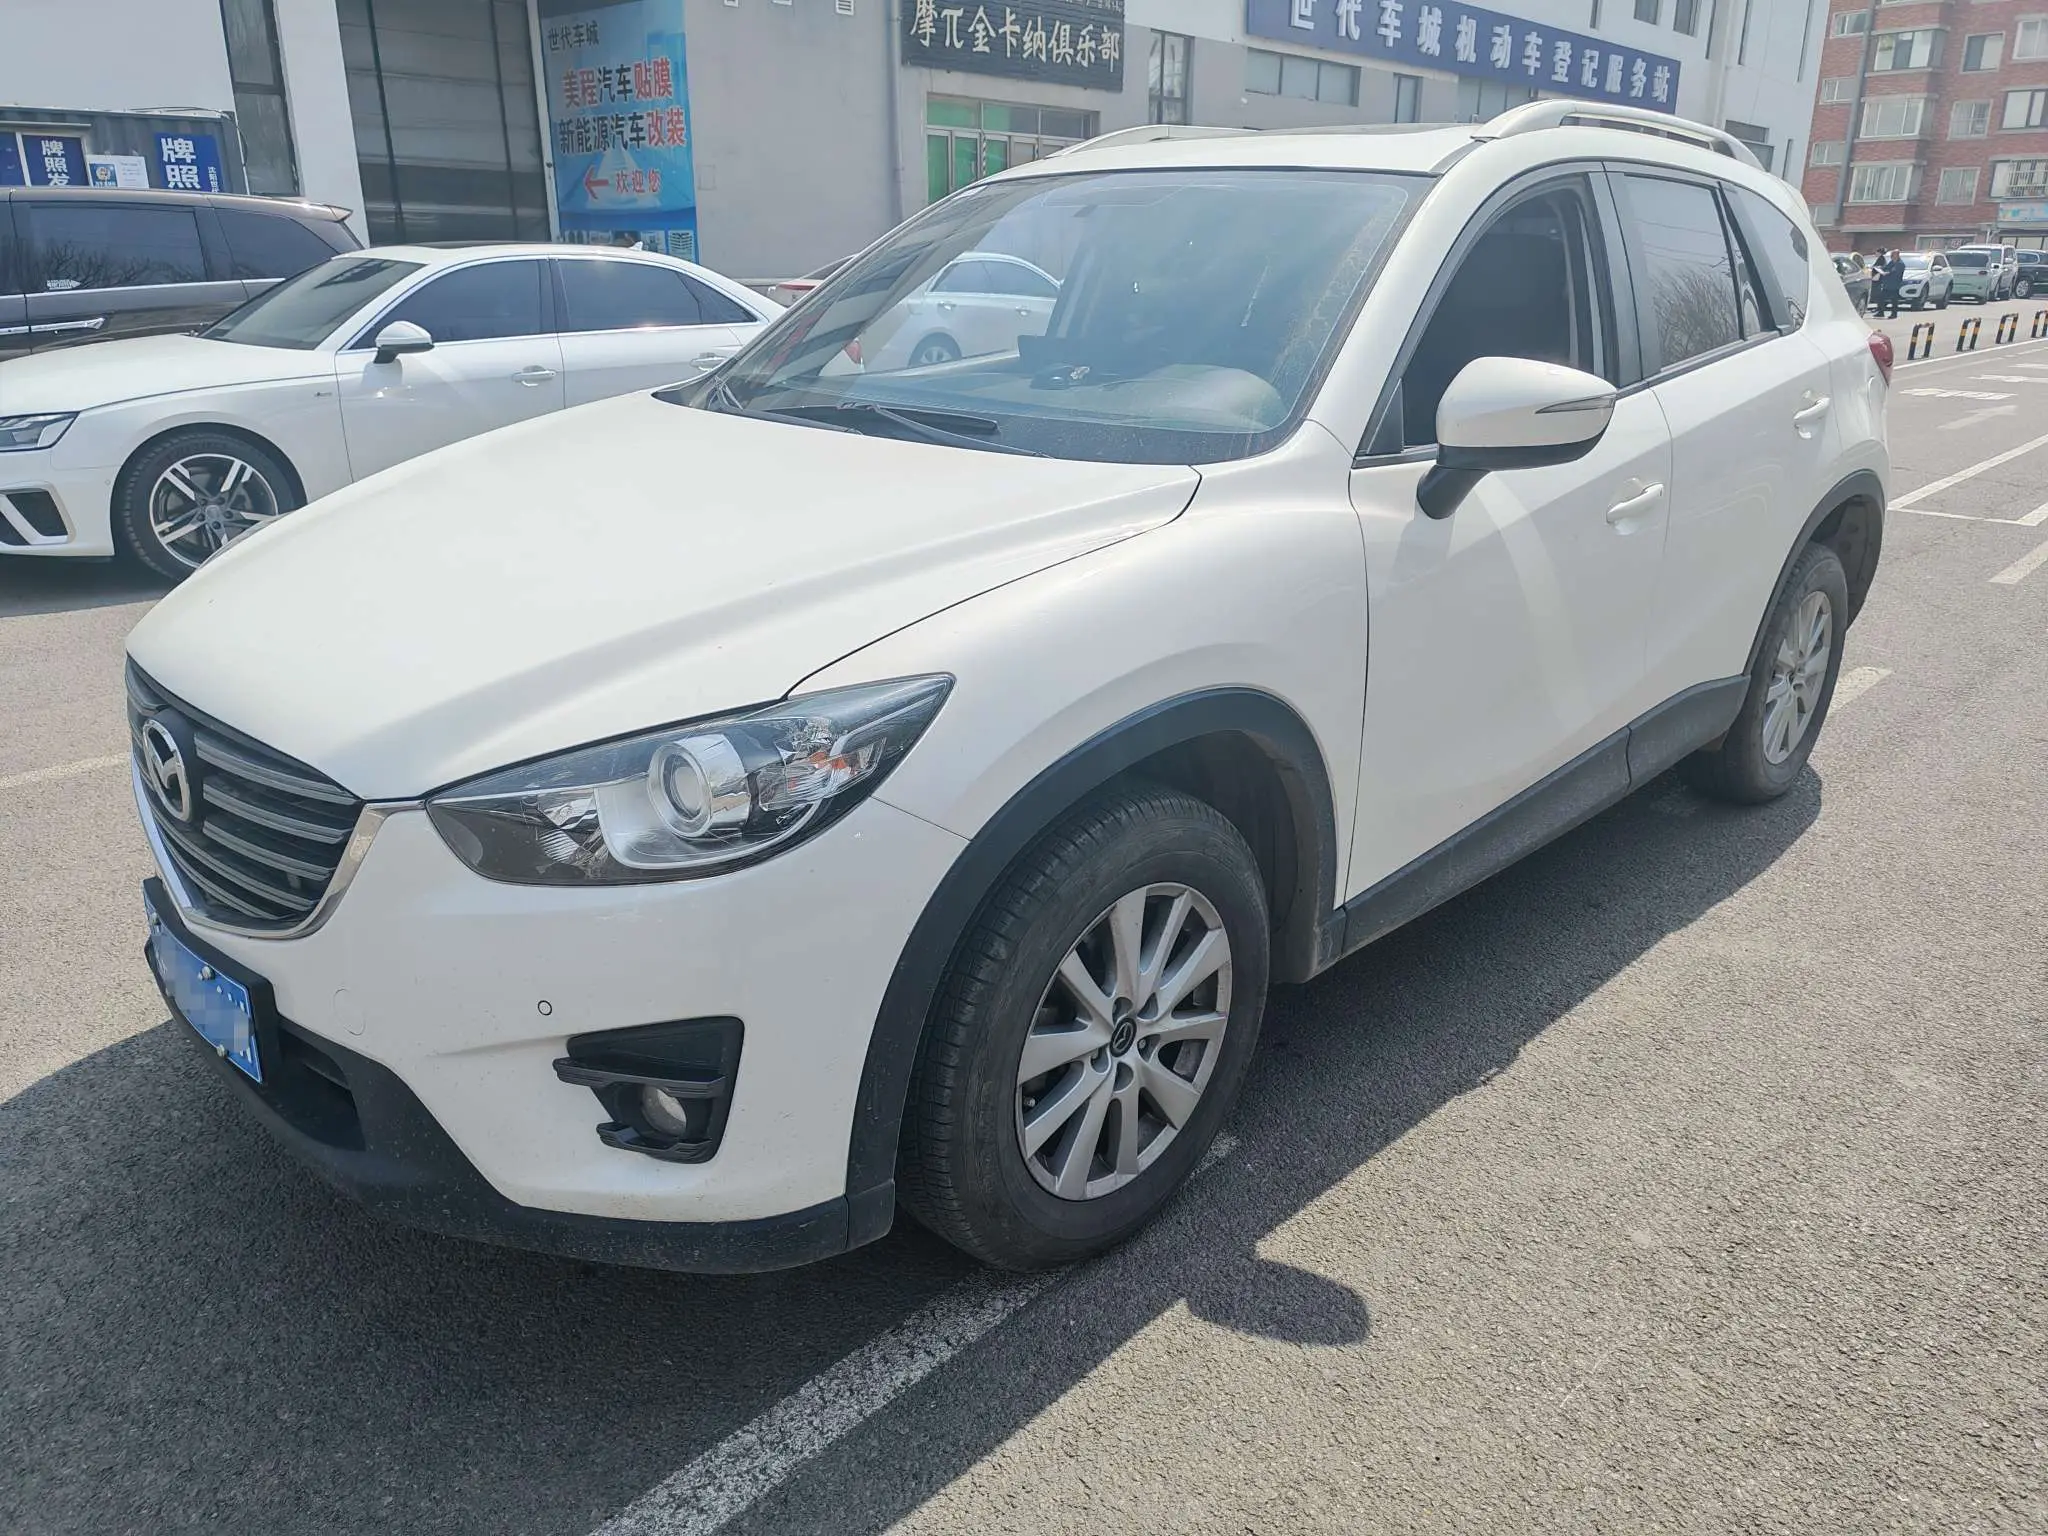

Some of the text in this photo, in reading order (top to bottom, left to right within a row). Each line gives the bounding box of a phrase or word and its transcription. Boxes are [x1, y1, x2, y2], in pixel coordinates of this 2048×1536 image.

[549, 20, 600, 50] 世代车城
[558, 107, 687, 154] 新能源汽车改装
[161, 137, 201, 189] 牌照
[615, 169, 661, 194] 欢迎您
